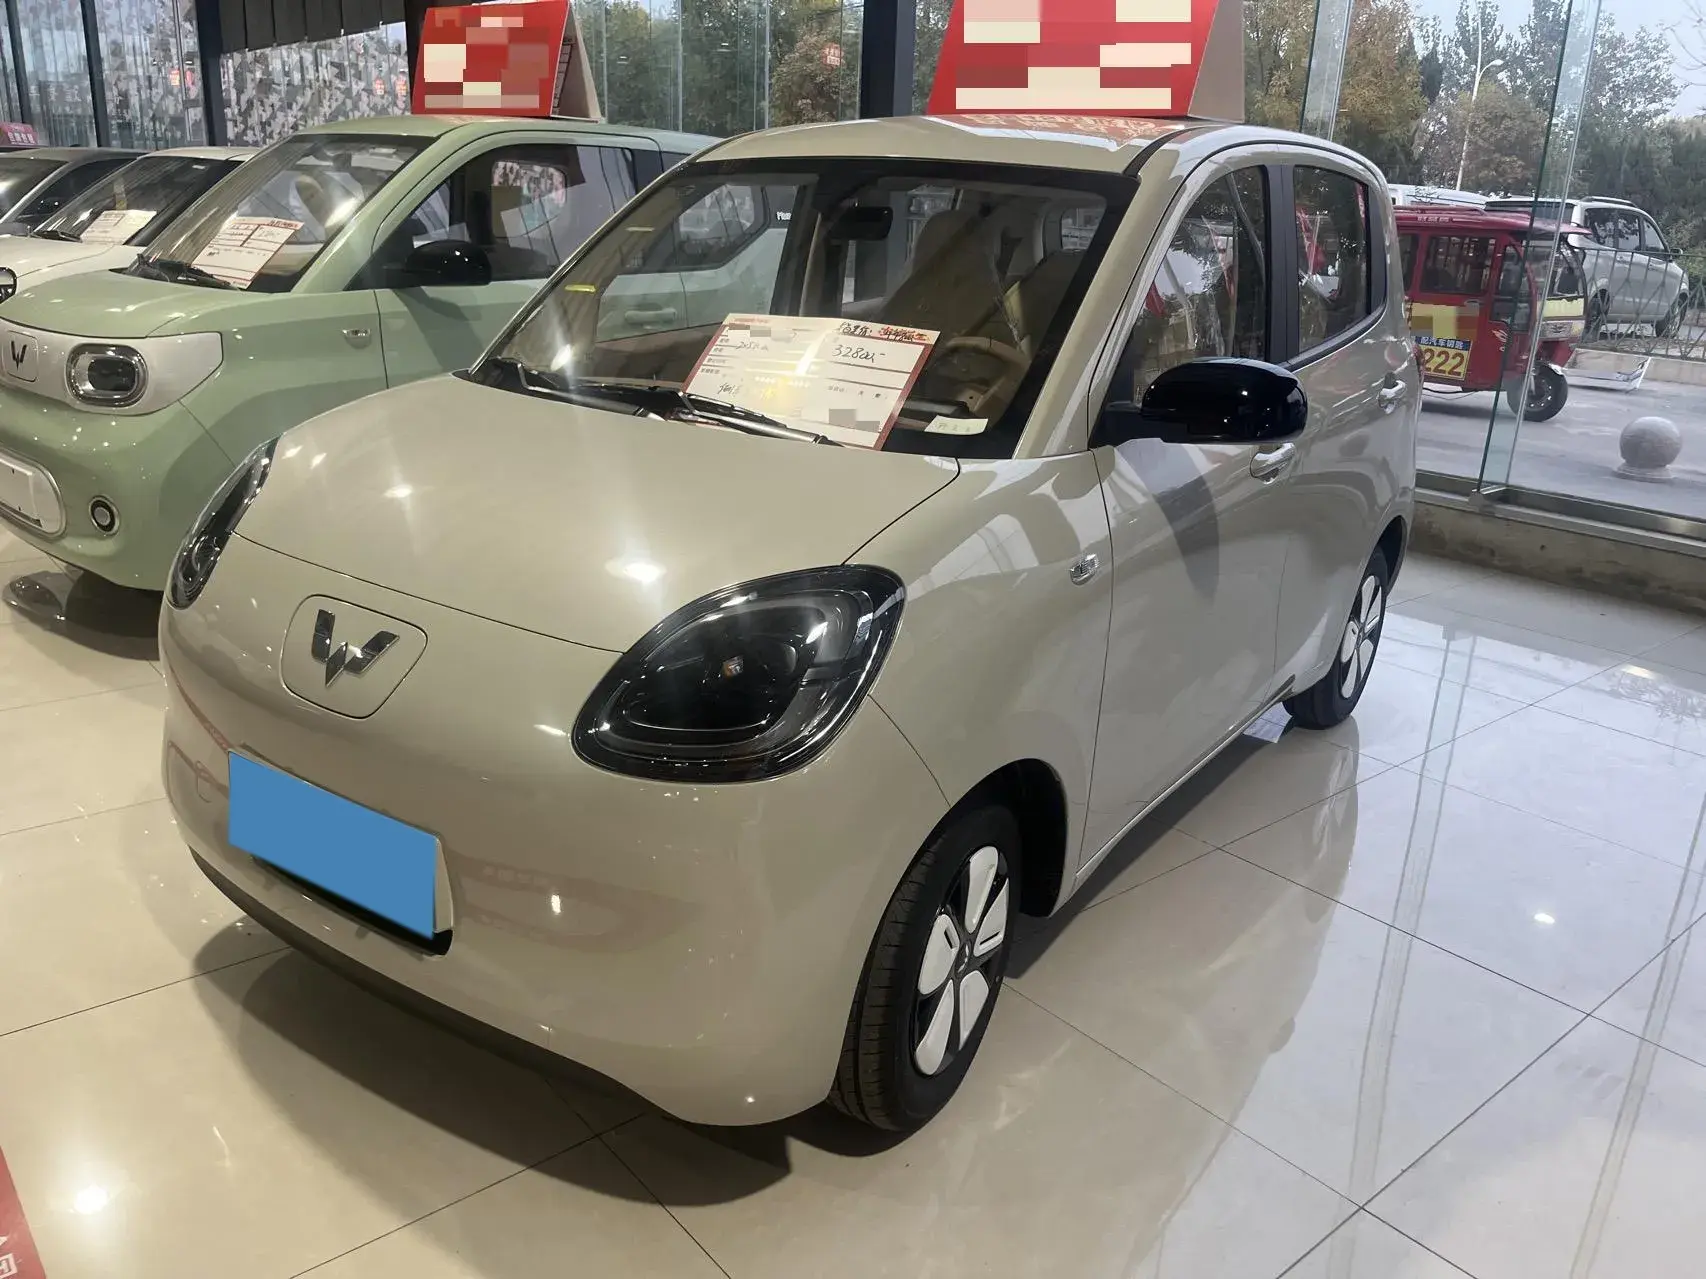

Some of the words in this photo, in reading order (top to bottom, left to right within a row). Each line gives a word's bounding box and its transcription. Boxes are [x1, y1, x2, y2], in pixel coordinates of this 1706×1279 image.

[1420, 336, 1465, 349] 配汽车钥匙
[1423, 347, 1465, 377] 222
